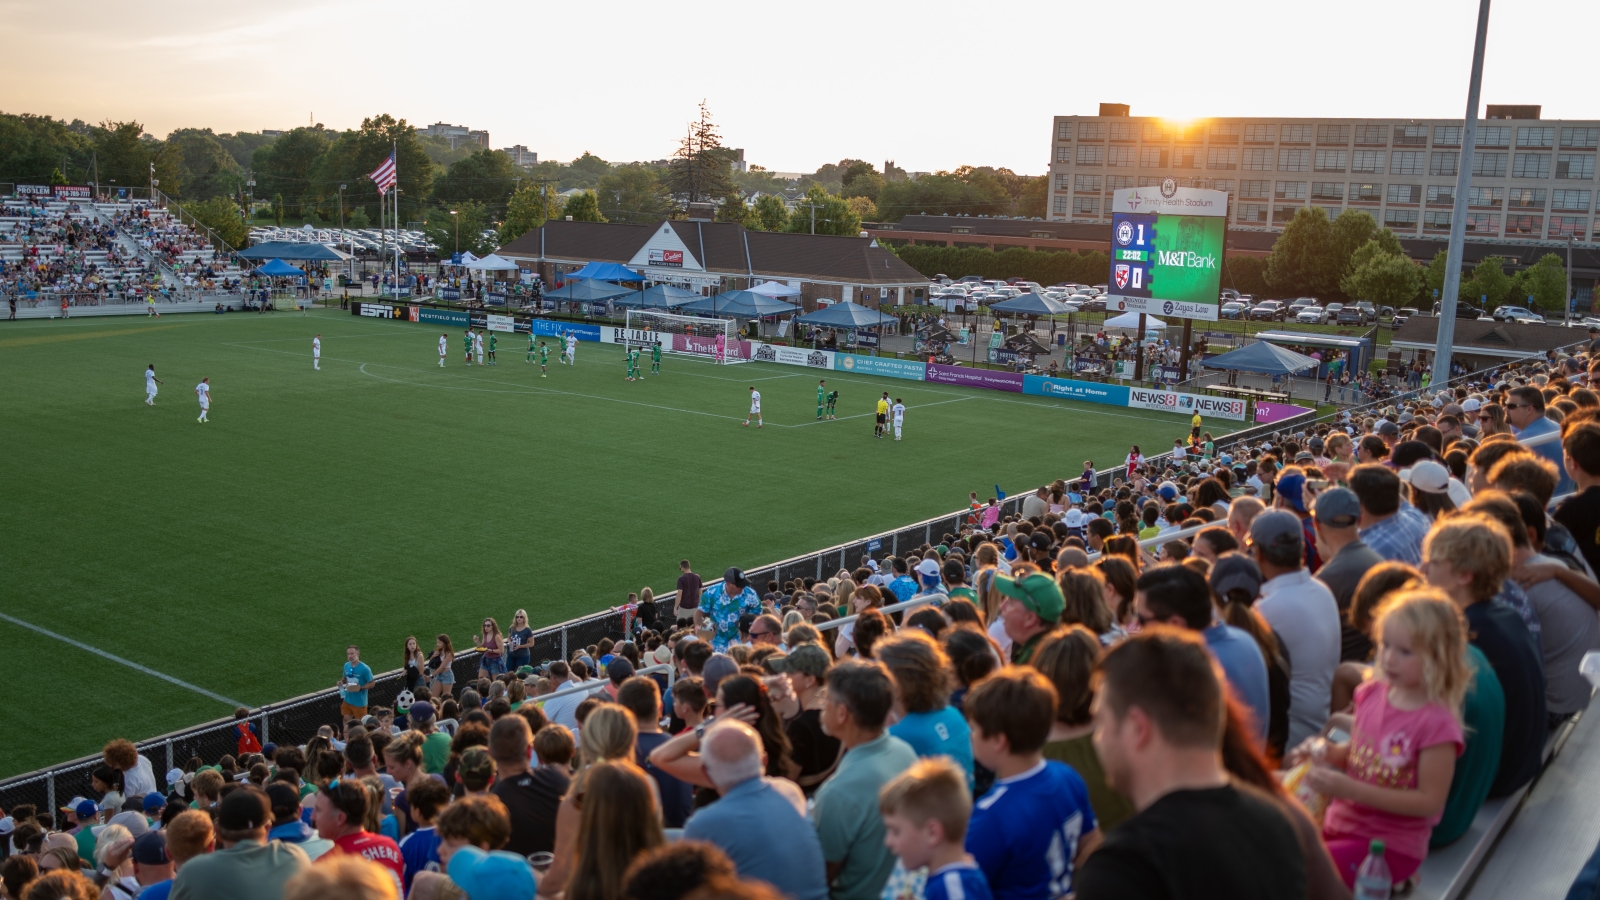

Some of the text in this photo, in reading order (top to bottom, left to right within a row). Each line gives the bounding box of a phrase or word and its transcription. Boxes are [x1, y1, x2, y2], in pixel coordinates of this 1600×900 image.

[1144, 197, 1213, 207] Trinity Health Stadium
[1137, 224, 1144, 245] 1
[1123, 250, 1141, 260] 22:02
[1158, 250, 1216, 269] M&T Bank
[1132, 267, 1143, 289] 0
[1175, 302, 1209, 314] Zayas Law
[420, 313, 450, 321] WESTFIELD
[536, 321, 550, 331] THE
[552, 323, 563, 332] FIX
[614, 328, 659, 342] REIABLE
[693, 342, 739, 357] The Haord
[875, 361, 903, 369] CRAFTED
[964, 373, 982, 381] Hospital
[1053, 384, 1073, 392] Right
[1085, 388, 1107, 396] Home
[1145, 402, 1176, 411] wtnh.com
[1209, 410, 1242, 419] wtnh.com
